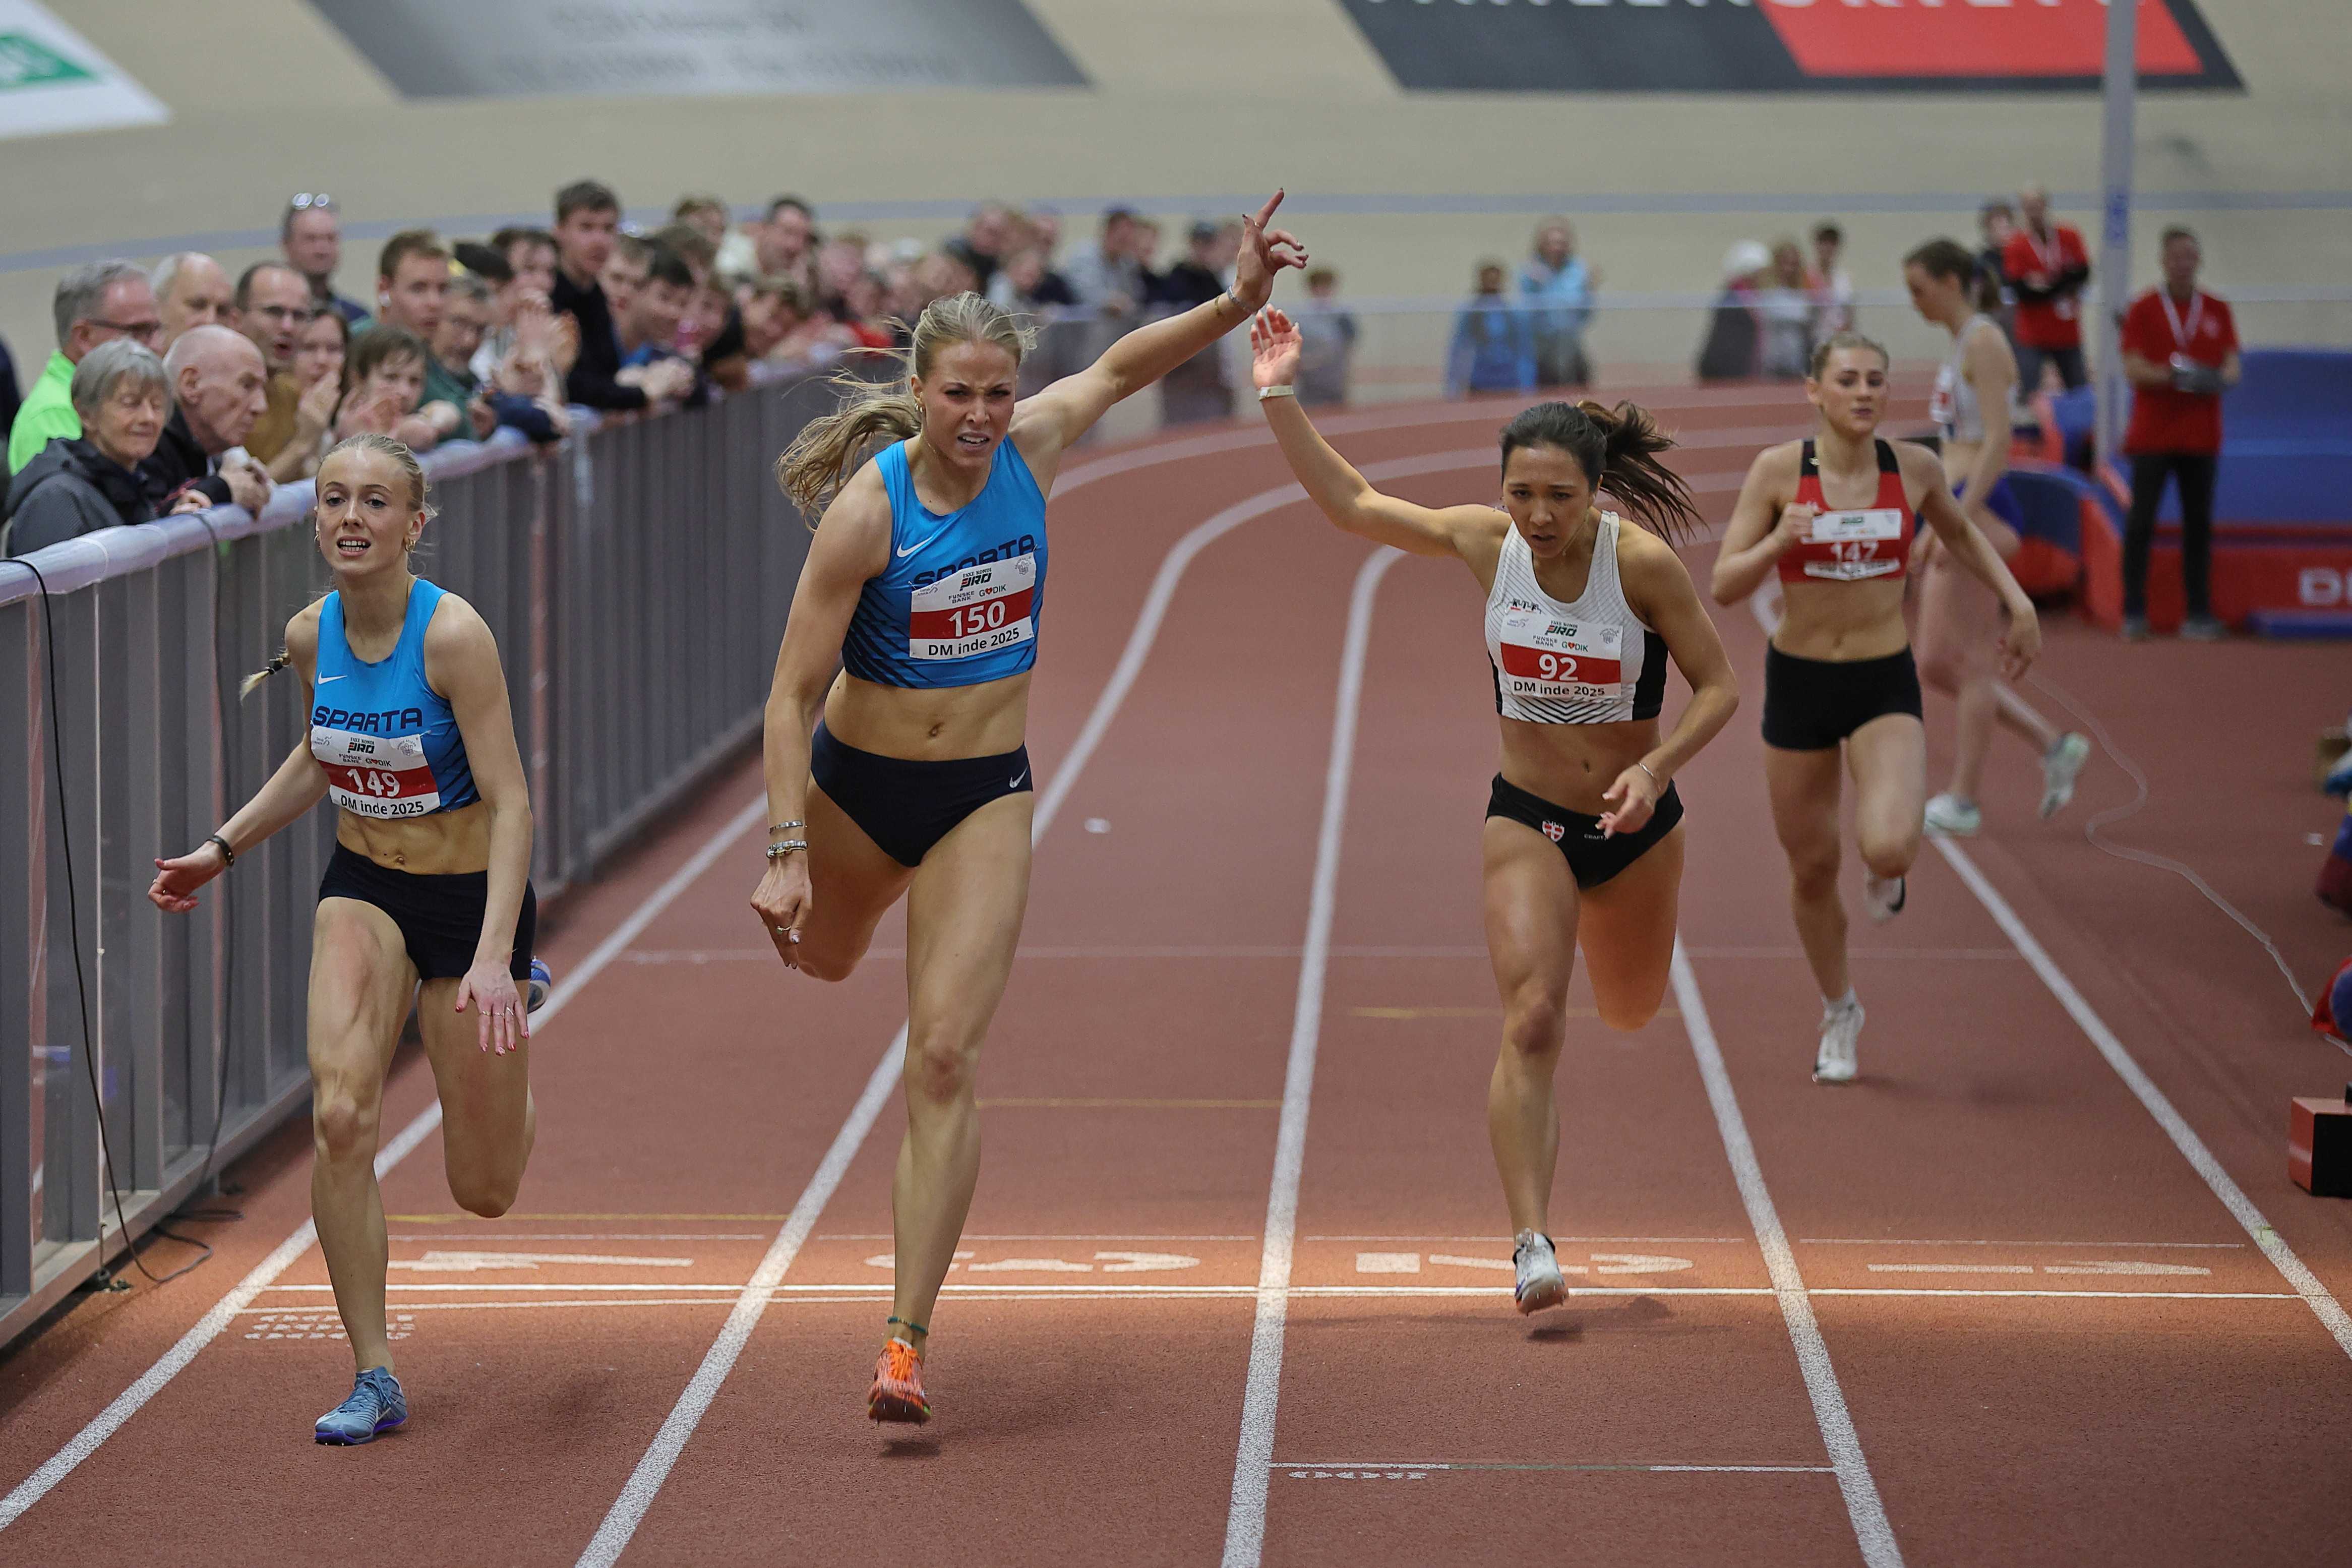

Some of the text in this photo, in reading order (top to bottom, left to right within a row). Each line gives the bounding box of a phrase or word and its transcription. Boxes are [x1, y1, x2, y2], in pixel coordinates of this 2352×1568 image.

[952, 596, 972, 604] BANK
[948, 600, 1006, 637] 150
[928, 627, 1020, 656] DM inde 2025
[1539, 653, 1578, 681] 92
[1514, 681, 1605, 697] DM inde 2025
[313, 706, 423, 732] SPARTA
[346, 768, 400, 797] 149
[340, 795, 424, 815] DM inde 2025
